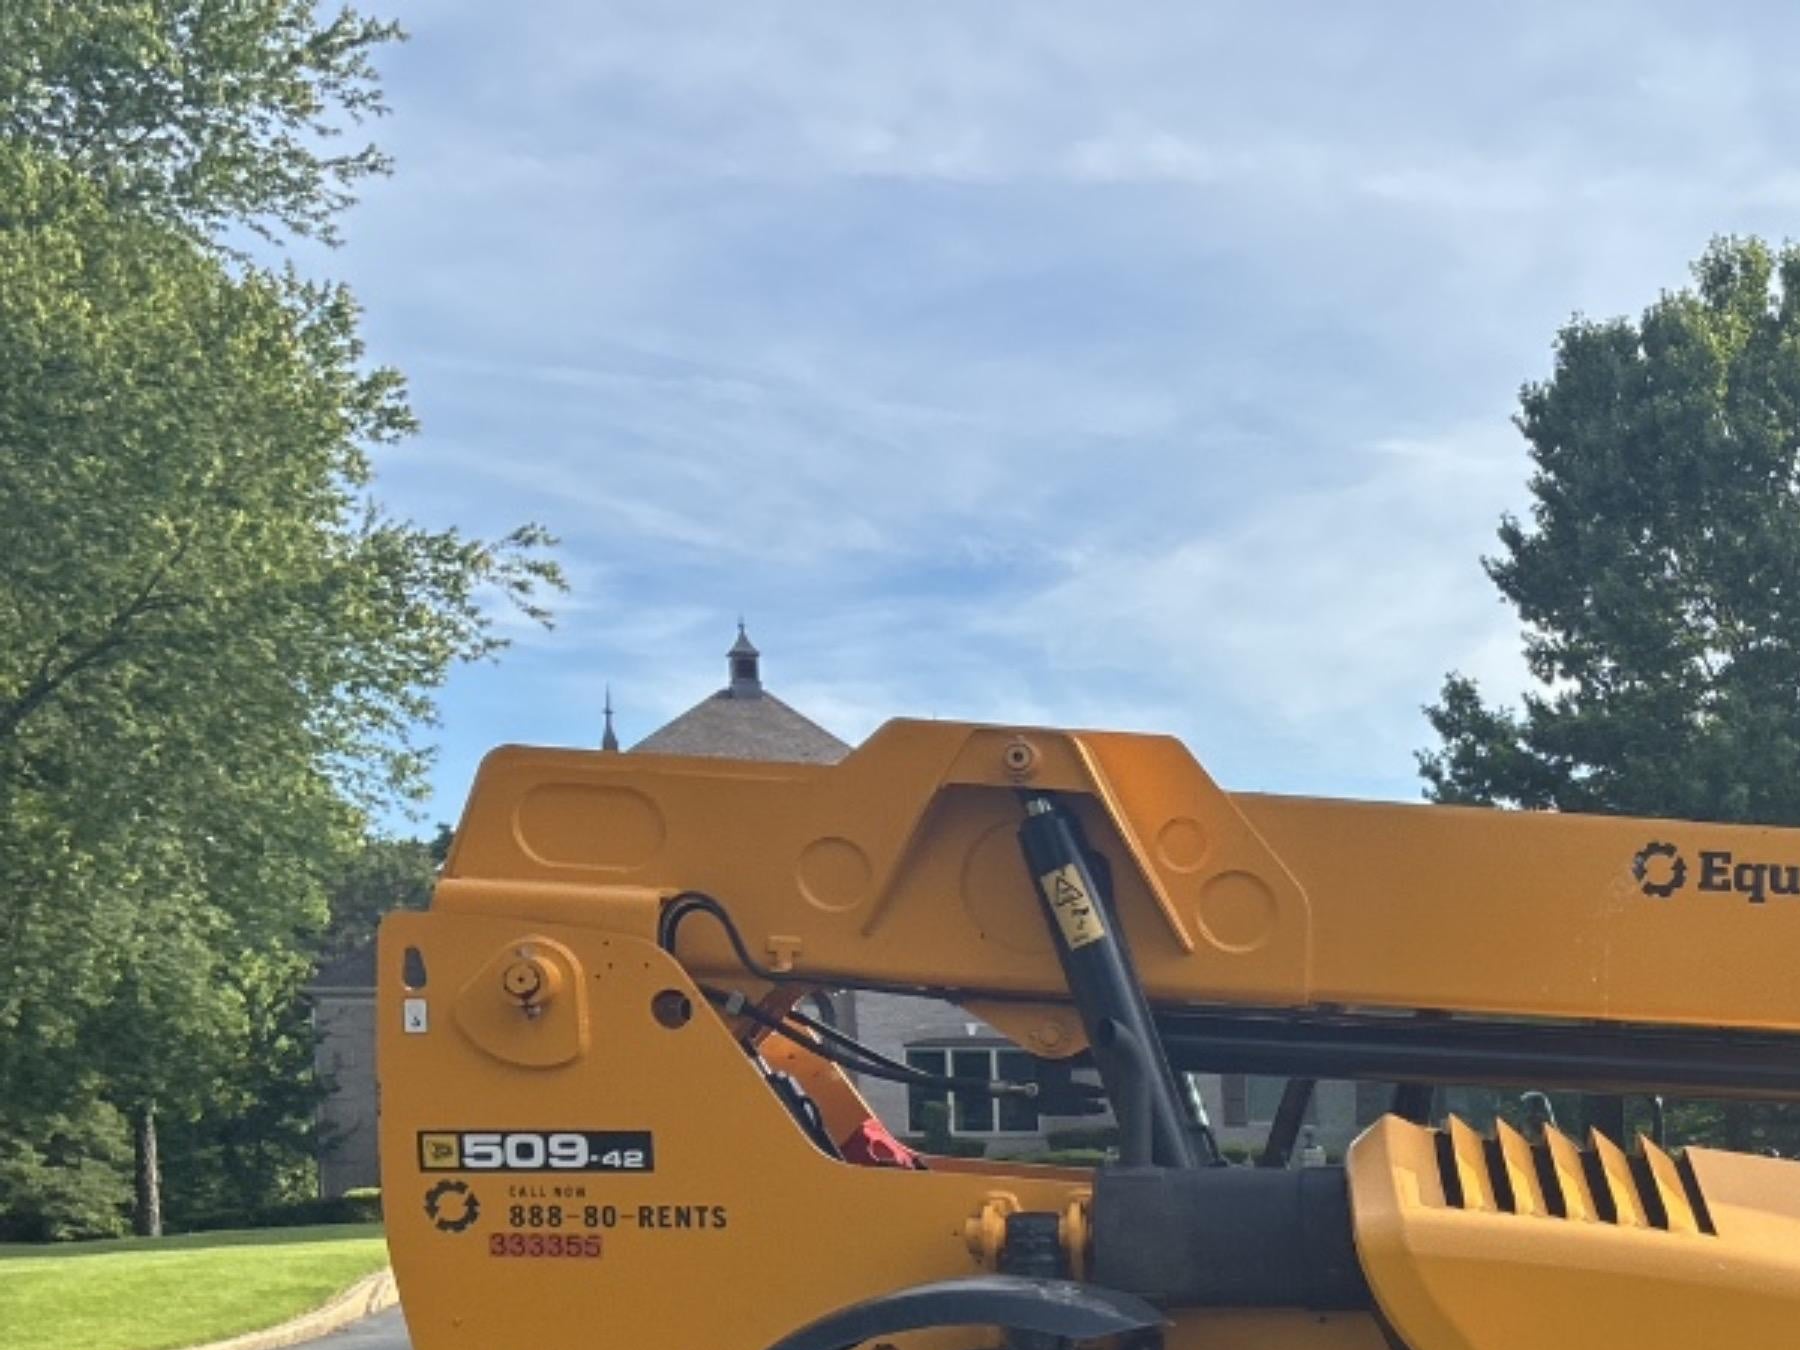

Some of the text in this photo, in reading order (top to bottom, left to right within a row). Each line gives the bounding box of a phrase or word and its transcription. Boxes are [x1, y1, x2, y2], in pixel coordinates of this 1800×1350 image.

[462, 1132, 645, 1169] 509-42
[508, 1185, 587, 1199] CALL NOW
[509, 1205, 728, 1229] 888-80-RENTS
[490, 1231, 603, 1258] 333355
